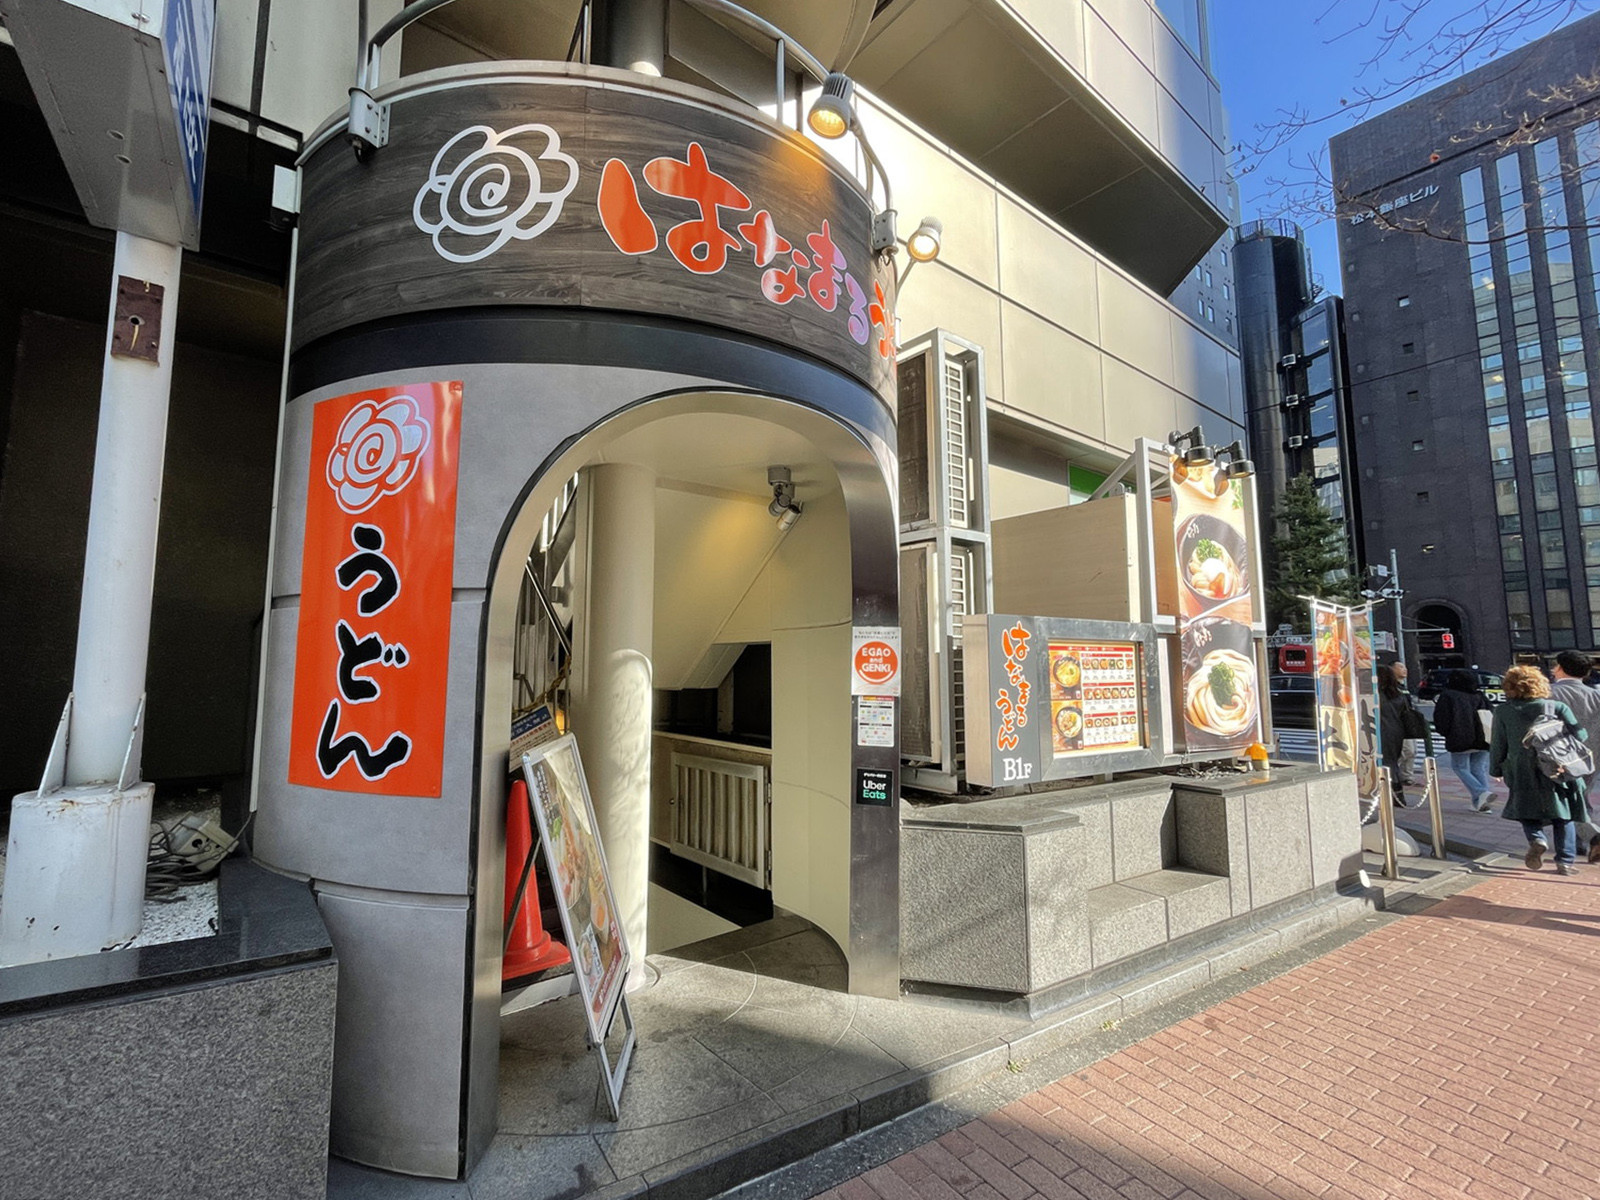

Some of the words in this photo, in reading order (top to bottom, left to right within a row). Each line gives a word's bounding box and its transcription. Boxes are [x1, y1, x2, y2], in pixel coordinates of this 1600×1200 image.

[315, 522, 412, 782] うどん
[861, 647, 892, 658] EGAO
[861, 663, 892, 673] GENKI
[1001, 620, 1032, 728] はなまる
[996, 688, 1020, 752] うどん
[1002, 757, 1032, 781] B1F
[863, 780, 886, 790] Uber
[863, 789, 886, 800] Eats
